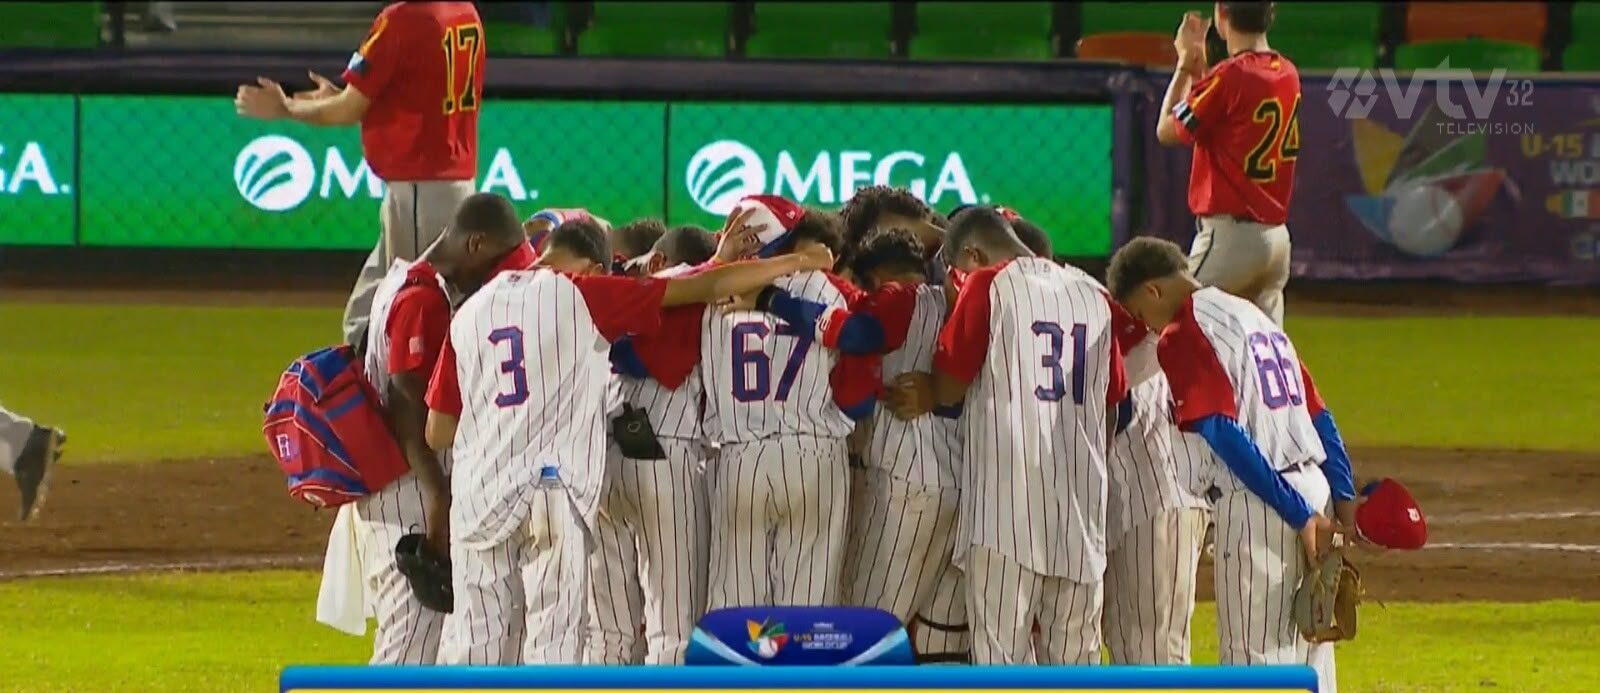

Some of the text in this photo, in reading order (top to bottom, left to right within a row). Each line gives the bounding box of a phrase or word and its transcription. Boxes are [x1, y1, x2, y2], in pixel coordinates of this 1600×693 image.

[442, 23, 480, 115] 17
[1244, 93, 1301, 183] 24
[1520, 132, 1583, 158] U-15
[487, 325, 531, 408] 3
[731, 321, 816, 403] 67
[1030, 319, 1088, 405] 31
[1247, 330, 1304, 410] 66
